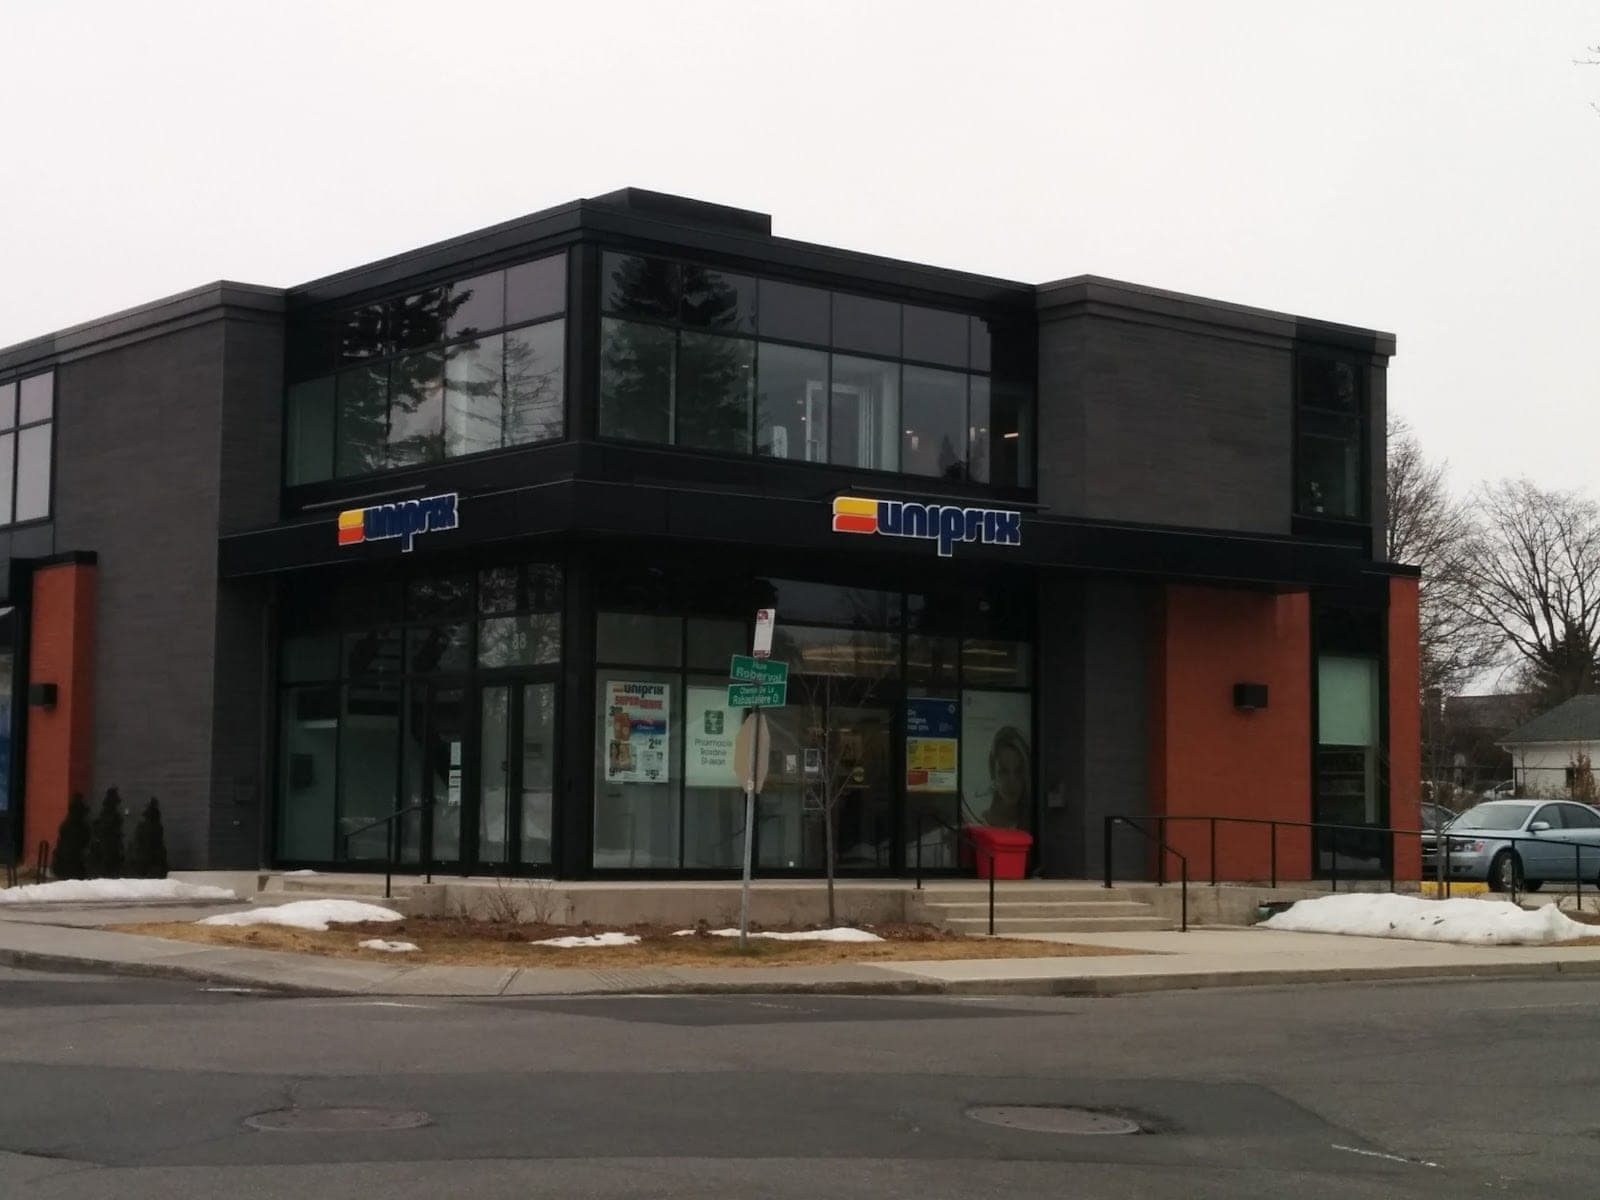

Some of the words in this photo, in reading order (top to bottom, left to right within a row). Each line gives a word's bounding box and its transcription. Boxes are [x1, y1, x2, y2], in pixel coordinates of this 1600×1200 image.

[877, 499, 1021, 557] uniprix
[736, 666, 782, 682] Roberval
[624, 684, 664, 698] uniprix
